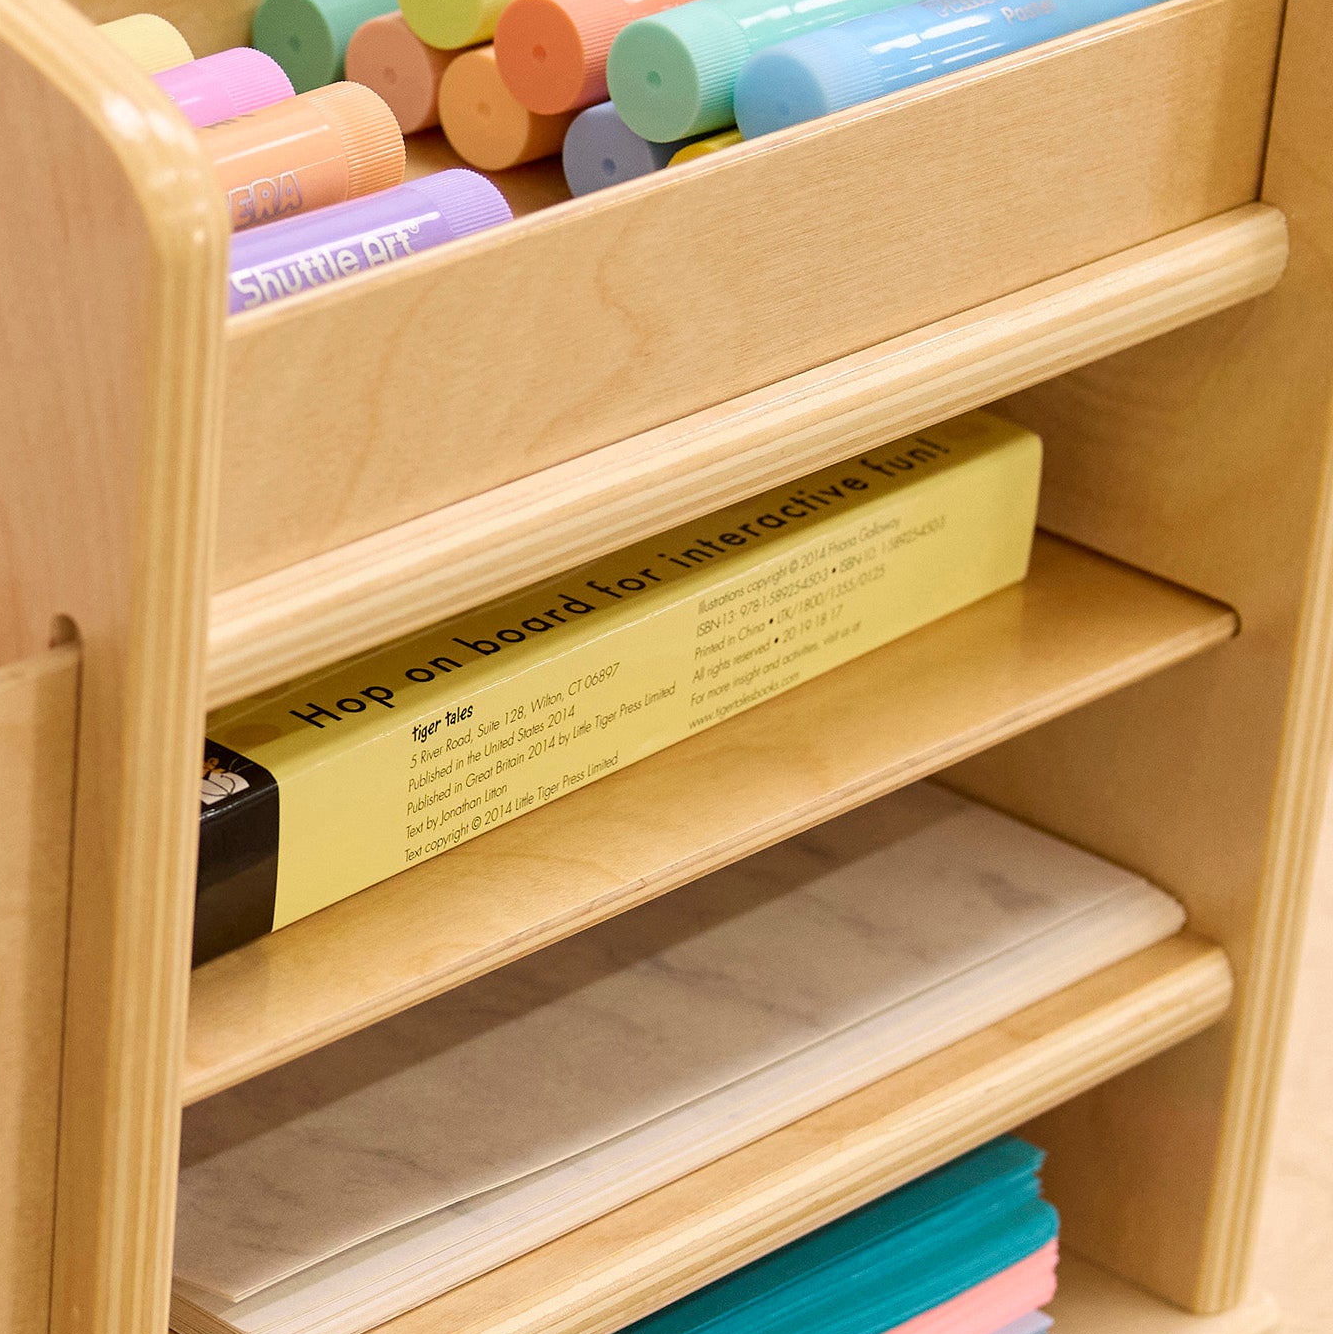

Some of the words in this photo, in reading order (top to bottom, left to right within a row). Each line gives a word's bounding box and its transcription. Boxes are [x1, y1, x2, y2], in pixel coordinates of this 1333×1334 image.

[228, 170, 303, 229] ERA
[231, 247, 361, 308] Shuttle
[288, 685, 396, 729] Hop
[404, 655, 464, 684] on
[453, 593, 597, 657] board
[586, 568, 662, 600] for
[658, 475, 870, 570] interactive
[861, 436, 951, 479] fun!
[698, 588, 745, 615] Illustrations
[746, 566, 788, 594] copyright
[800, 547, 827, 570] 2014
[691, 667, 706, 684] All
[707, 658, 731, 680] rights
[733, 638, 771, 665] reserved
[694, 636, 726, 661] Printed
[727, 635, 736, 647] in
[737, 623, 766, 642] China
[690, 693, 706, 707] For
[707, 683, 731, 699] more
[732, 666, 762, 688] insight
[762, 656, 781, 675] and
[409, 754, 418, 770] 5
[420, 746, 444, 765] River
[445, 728, 474, 753] Road,
[476, 721, 501, 739] Suite
[505, 705, 527, 725] 128,
[530, 693, 564, 714] Wilton,
[567, 679, 583, 697] CT
[583, 662, 621, 690] 06897
[411, 720, 442, 744] tiger
[444, 705, 474, 727] tales
[406, 783, 452, 817] Published
[453, 782, 463, 794] in
[465, 767, 494, 788] Great
[495, 754, 525, 775] Britain
[527, 736, 556, 761] 2014
[558, 733, 571, 747] by
[572, 721, 593, 740] Little
[594, 711, 618, 730] Tiger
[619, 701, 642, 718] Press
[644, 681, 677, 707] Limited
[408, 759, 454, 793] Published
[455, 759, 465, 771] in
[466, 751, 482, 765] the
[483, 731, 515, 758] United
[517, 723, 545, 743] States
[547, 705, 575, 729] 2014
[404, 846, 423, 863] Text
[424, 823, 470, 854] copyright
[484, 801, 513, 826] 2014
[515, 793, 535, 812] Little
[537, 783, 561, 802] Tiger
[562, 771, 586, 789] Press
[587, 753, 619, 778] Limited
[405, 822, 424, 839] Text
[425, 816, 439, 831] by
[439, 797, 482, 827] Jonathan
[484, 785, 508, 803] Litton
